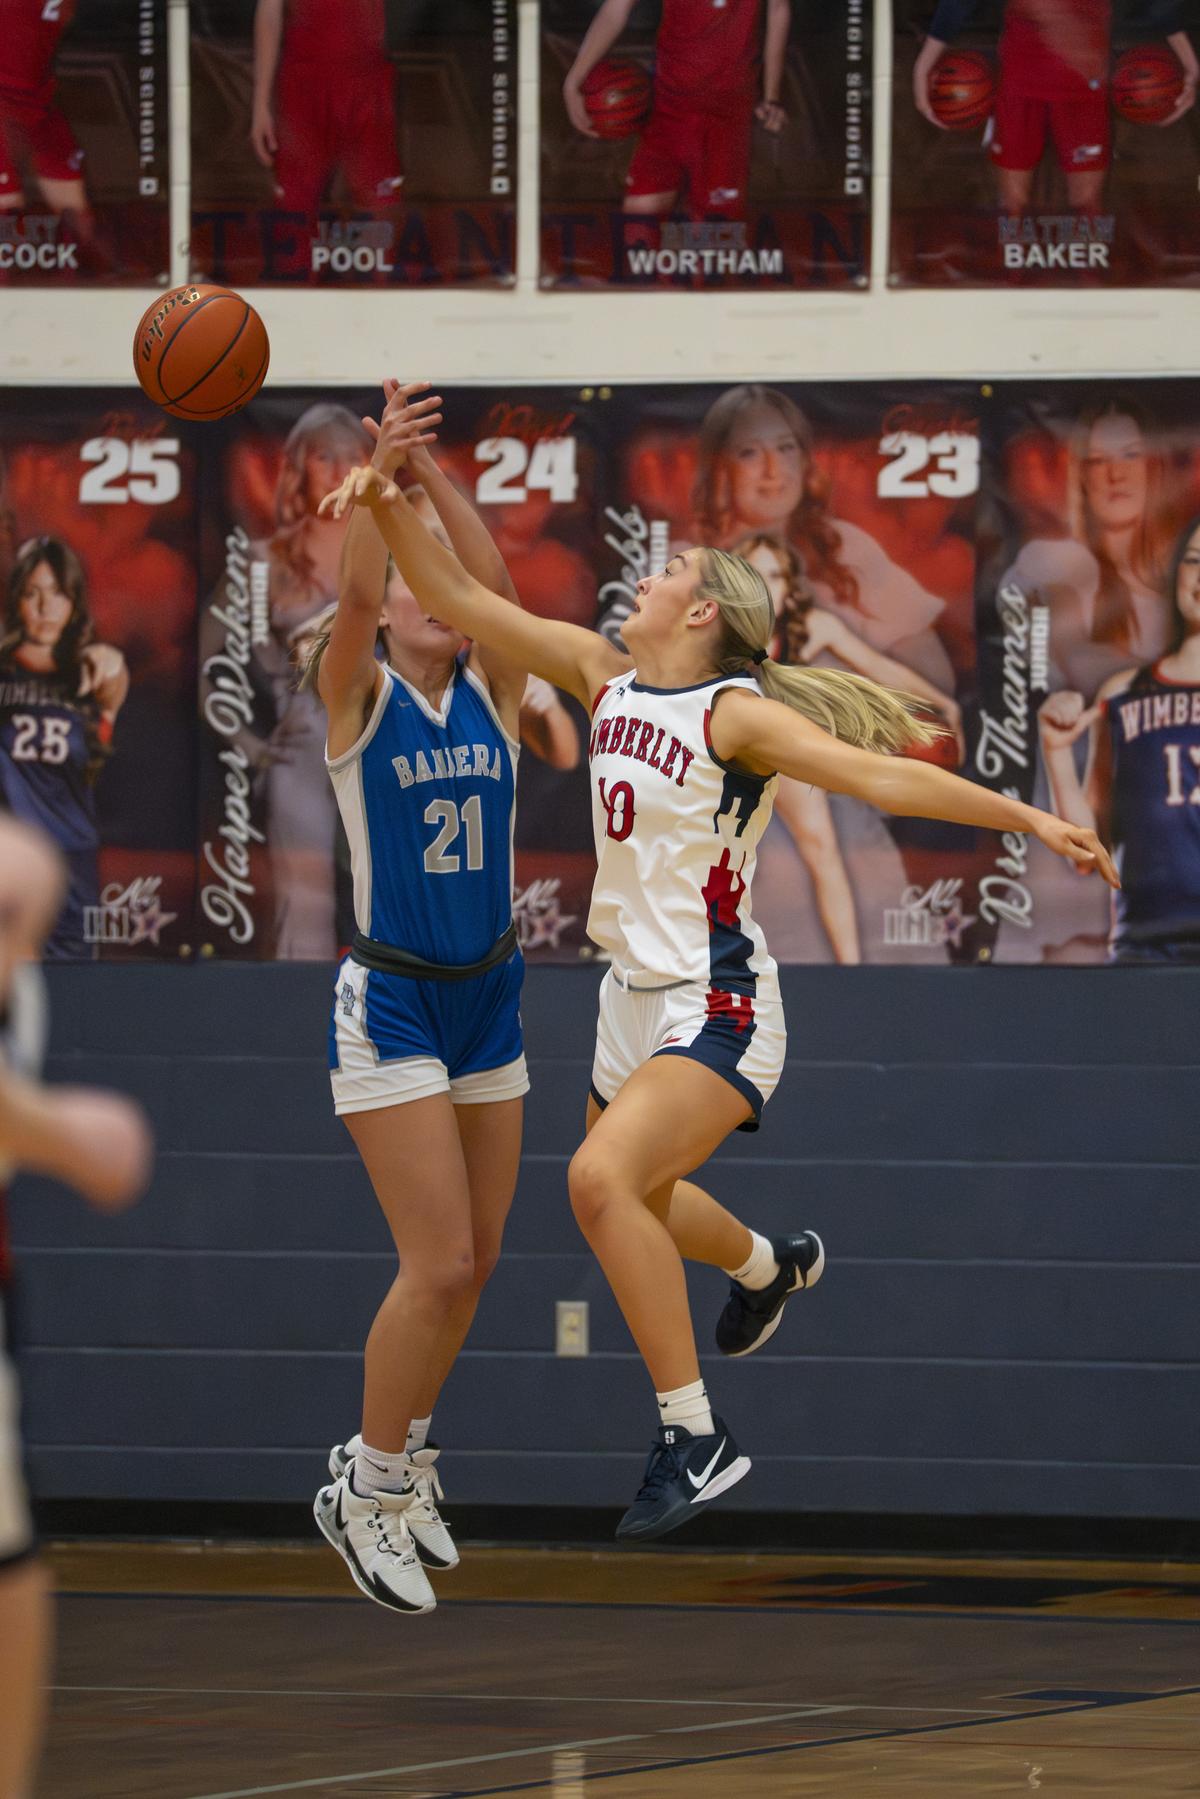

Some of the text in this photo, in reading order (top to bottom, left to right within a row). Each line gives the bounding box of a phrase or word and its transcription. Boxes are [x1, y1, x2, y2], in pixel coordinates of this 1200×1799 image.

[312, 247, 393, 273] POOL
[627, 248, 783, 275] WORTHAM
[1004, 243, 1110, 269] BAKER
[79, 437, 180, 504] 25
[475, 436, 578, 503] 24
[878, 431, 980, 498] 23
[1031, 606, 1049, 690] JUNIOR
[11, 714, 72, 764] 25
[200, 525, 267, 944] Harper Wakem
[976, 583, 1032, 929] Dre Thames
[424, 796, 484, 874] 21
